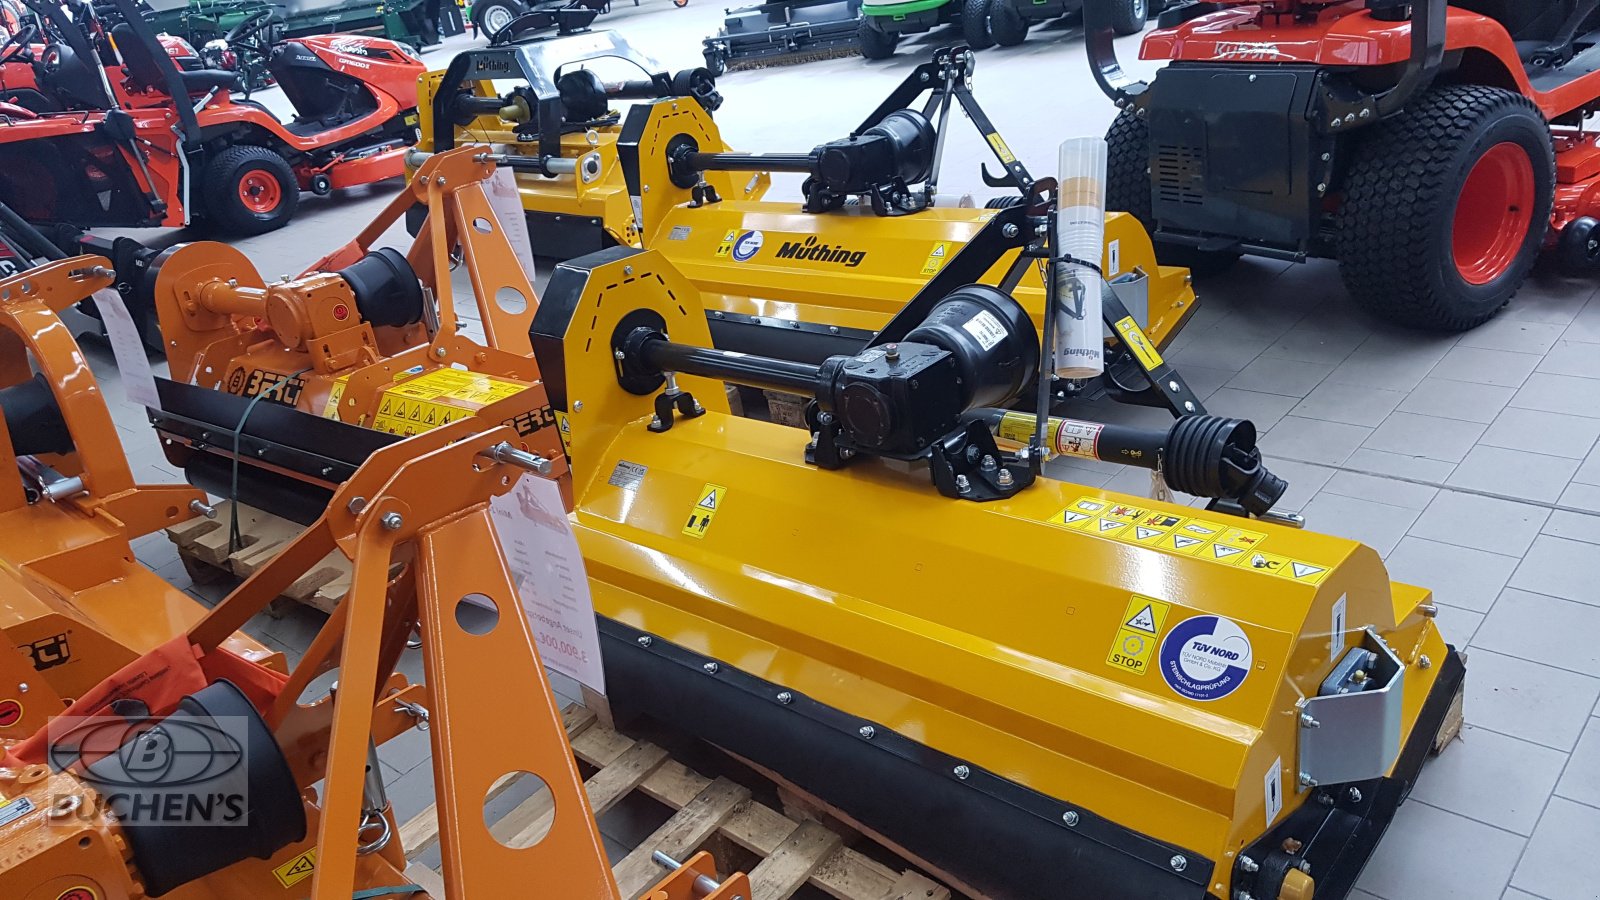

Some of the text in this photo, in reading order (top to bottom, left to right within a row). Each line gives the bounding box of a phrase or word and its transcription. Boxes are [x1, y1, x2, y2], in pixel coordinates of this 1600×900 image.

[775, 235, 867, 268] Müthing
[1063, 347, 1100, 361] Müthing
[1112, 653, 1144, 669] STOP
[1192, 641, 1240, 661] TÜV NORD
[1169, 660, 1232, 691] STEINSCHLAGPRÜFUNG
